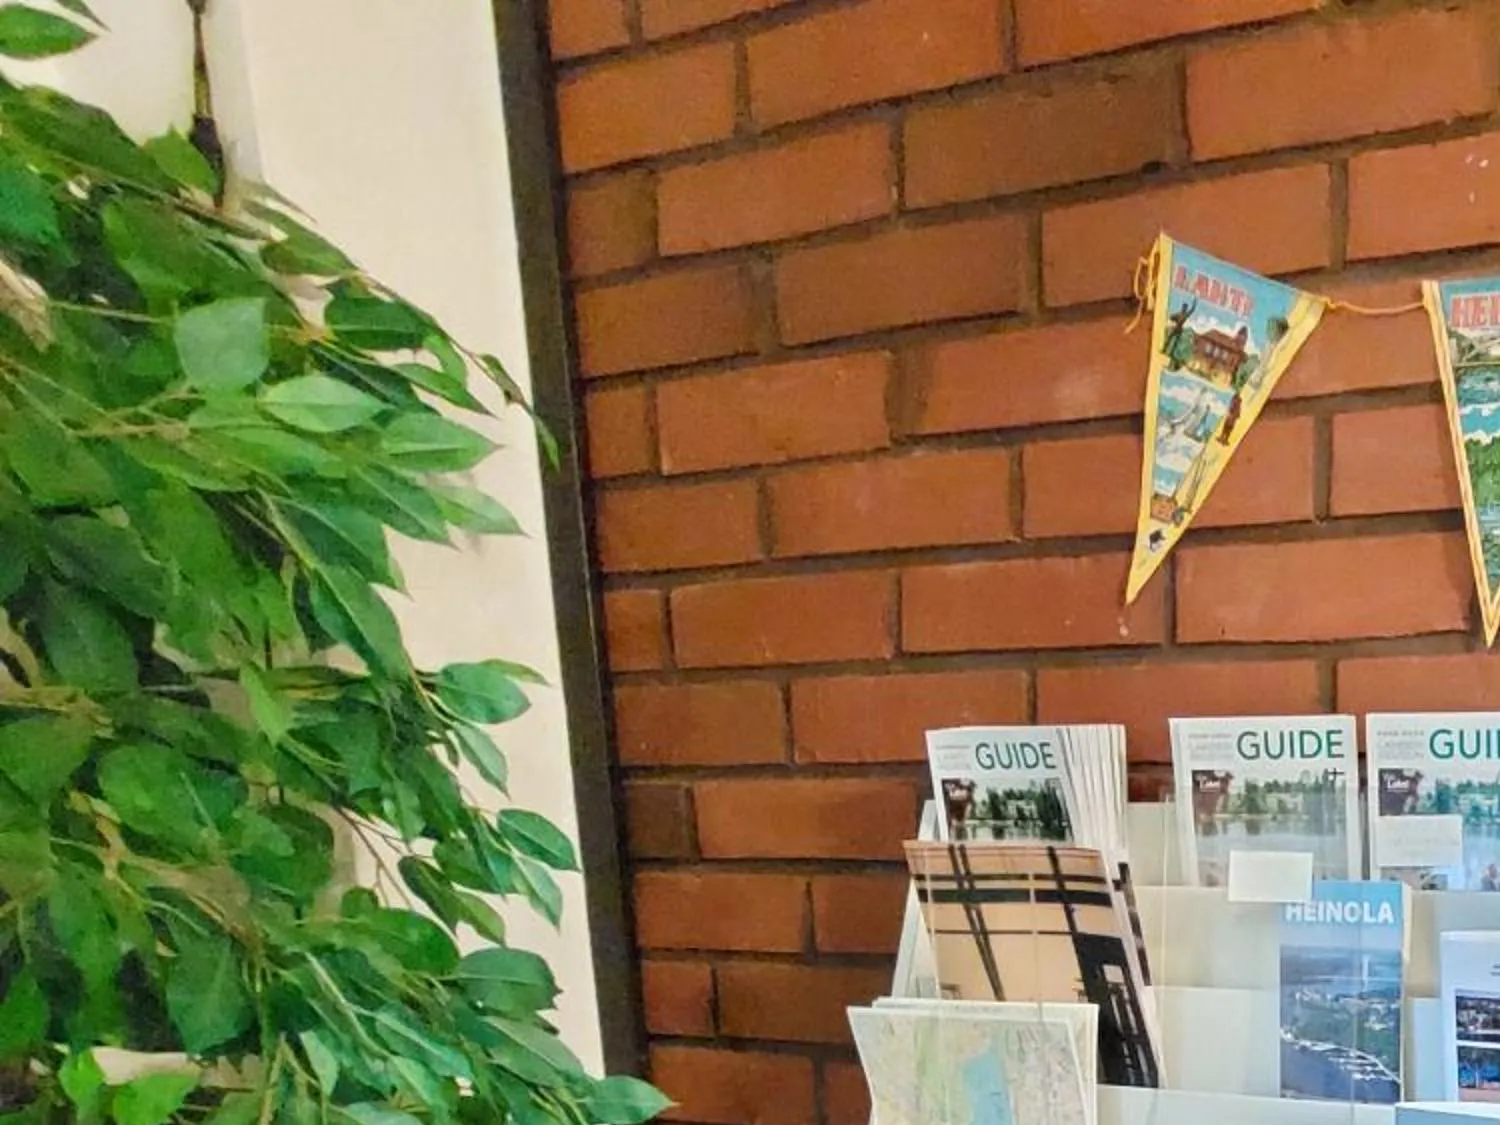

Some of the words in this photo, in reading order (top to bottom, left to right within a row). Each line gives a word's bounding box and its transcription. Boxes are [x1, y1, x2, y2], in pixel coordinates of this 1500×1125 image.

[976, 741, 1057, 770] GUIDE
[1236, 729, 1345, 760] GUIDE
[1285, 900, 1395, 925] HEINOLA
